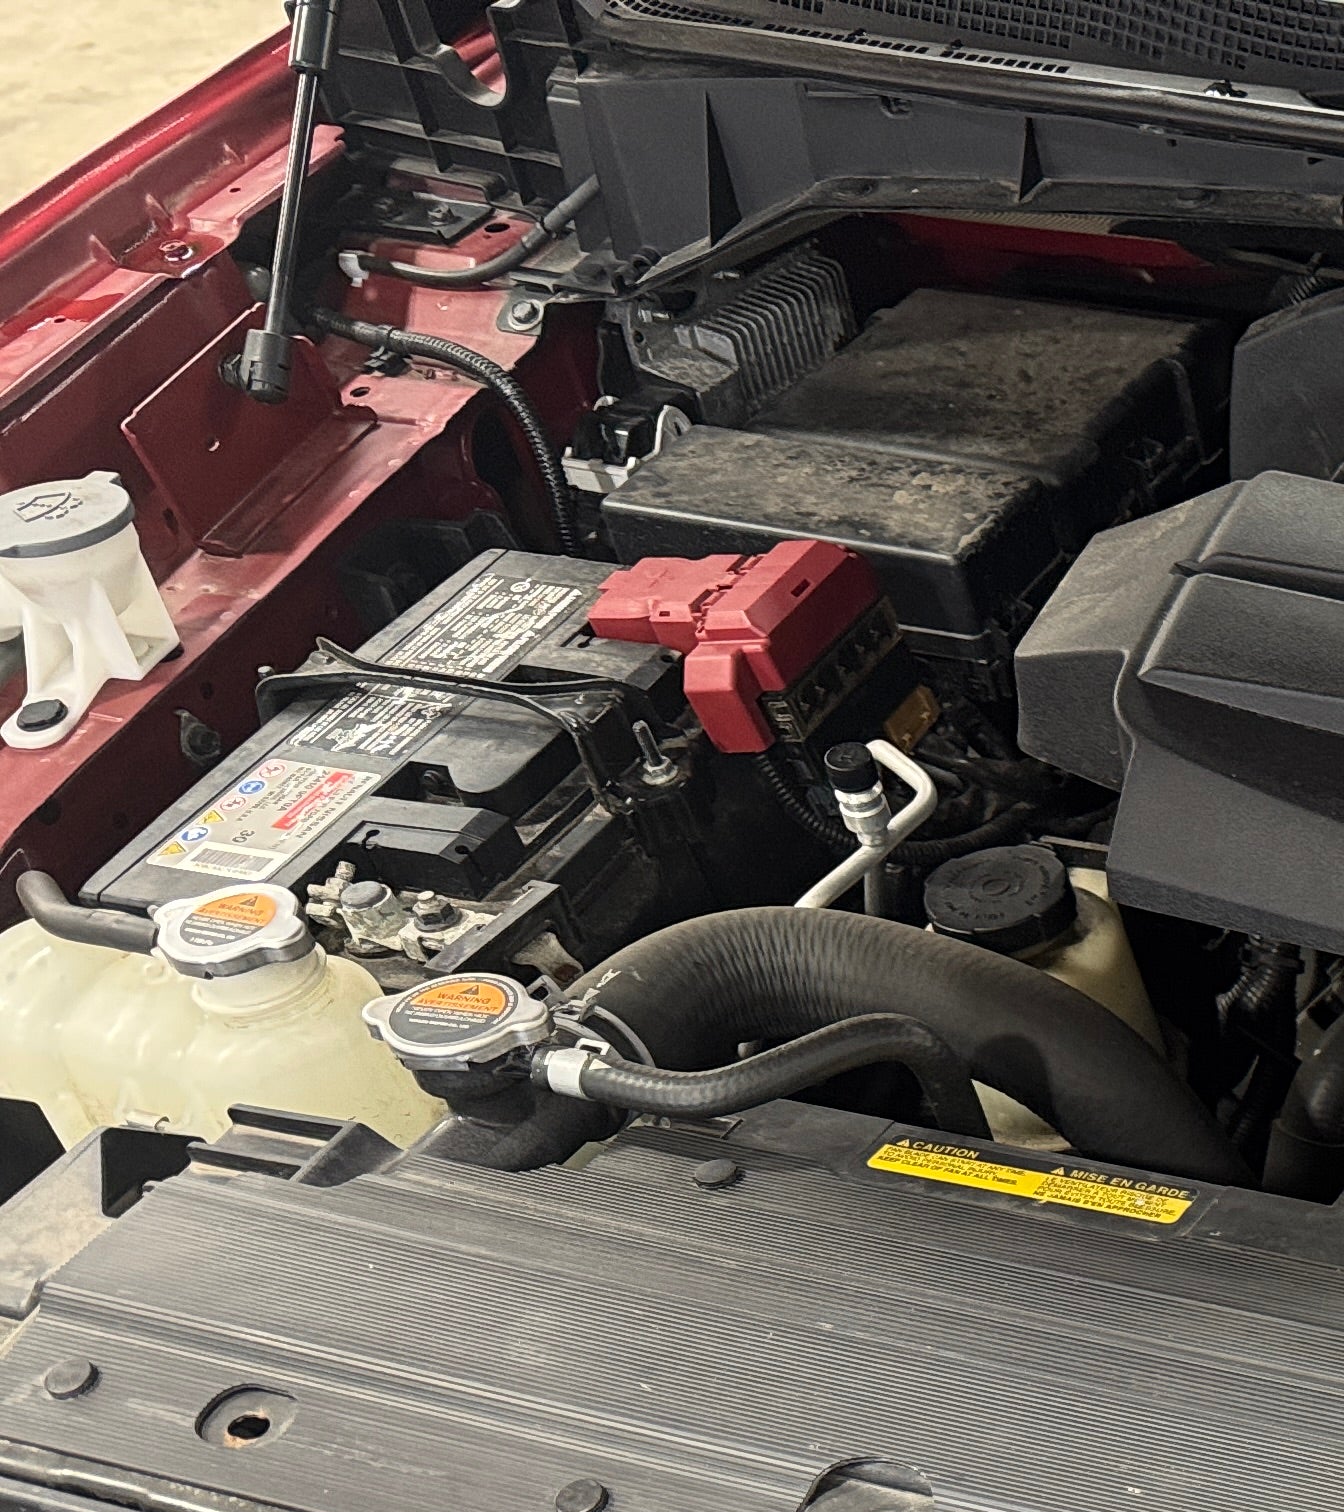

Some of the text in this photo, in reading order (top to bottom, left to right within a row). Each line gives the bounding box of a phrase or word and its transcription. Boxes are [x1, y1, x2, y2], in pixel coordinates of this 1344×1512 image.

[295, 807, 336, 838] NISSAN
[229, 829, 256, 843] 30
[417, 998, 499, 1012] AVERTISSEMENT
[437, 992, 491, 1004] WARNING
[913, 1141, 980, 1159] CAUTION
[901, 1159, 930, 1168] CLEAR
[1070, 1170, 1190, 1199] MISE EN GARDE
